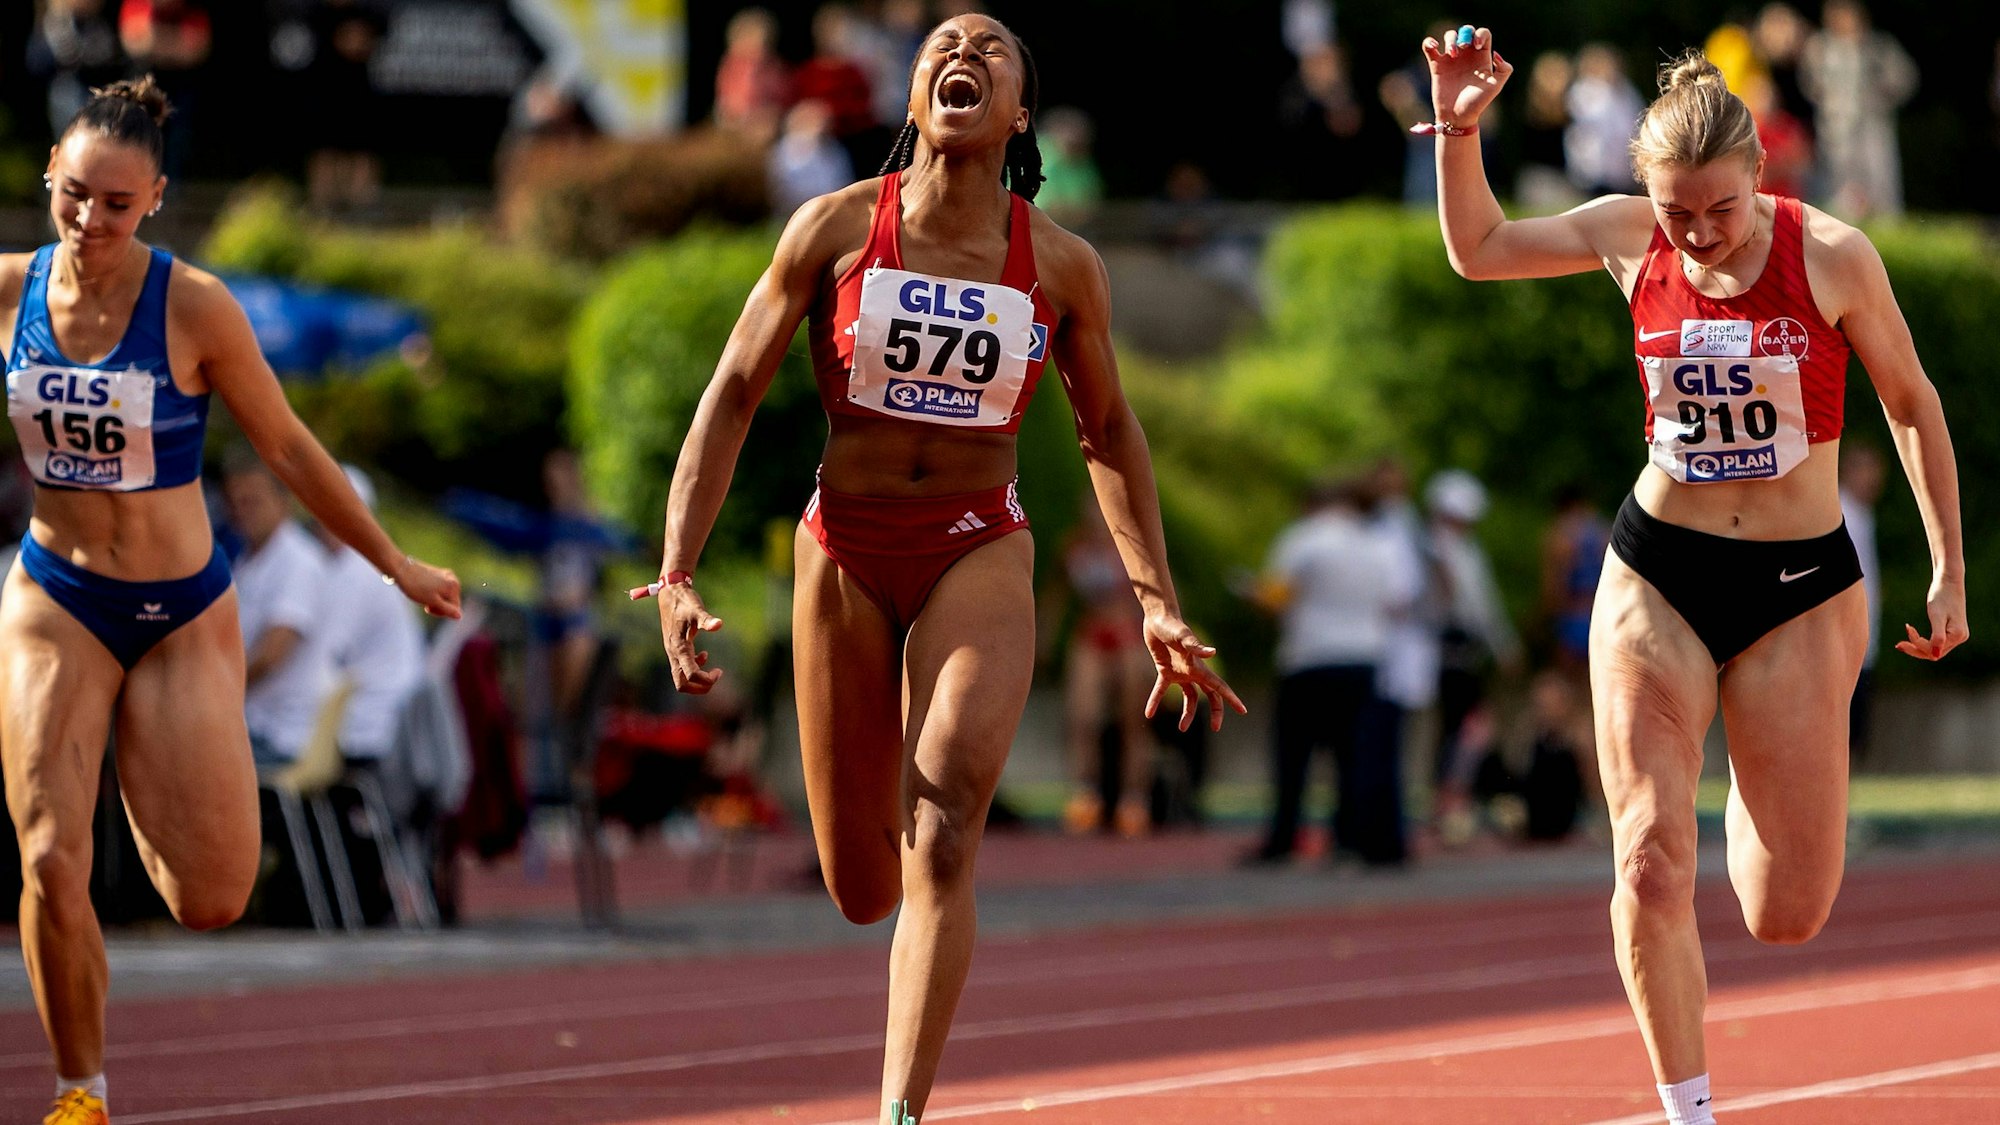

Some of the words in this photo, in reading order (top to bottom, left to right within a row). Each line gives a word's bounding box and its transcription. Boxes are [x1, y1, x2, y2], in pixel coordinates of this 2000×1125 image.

[1708, 325, 1736, 334] SPORT
[1707, 334, 1748, 343] STIFTUNG
[1763, 335, 1806, 345] BAYER
[883, 318, 1001, 384] 579
[1707, 343, 1728, 352] NRW
[925, 387, 977, 407] PLAN
[924, 404, 975, 414] INTERNATIONAL
[1677, 400, 1778, 445] 910
[32, 409, 126, 454] 156
[1722, 452, 1773, 470] PLAN
[1724, 468, 1773, 477] INTERNATIONAL
